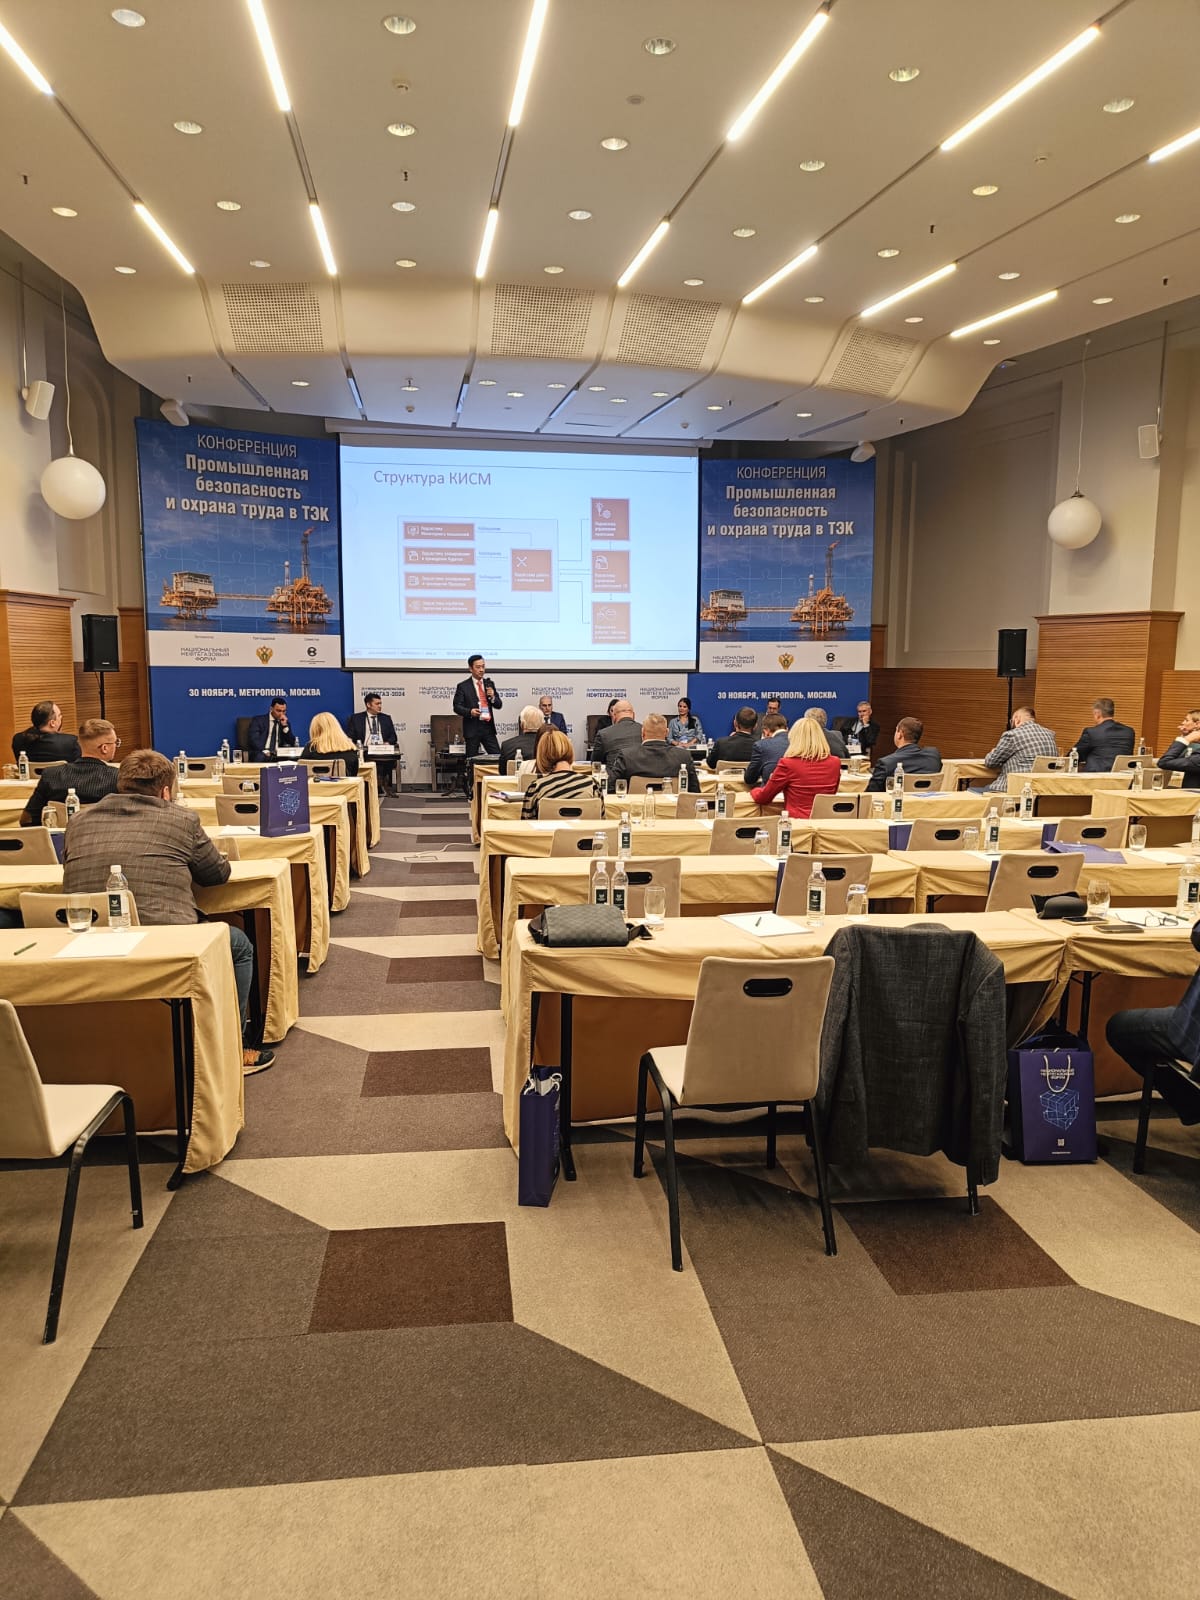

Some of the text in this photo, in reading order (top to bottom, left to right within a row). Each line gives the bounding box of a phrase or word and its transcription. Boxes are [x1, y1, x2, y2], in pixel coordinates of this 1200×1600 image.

[197, 434, 297, 458] КОНФЕРЕНЦИЯ
[185, 453, 309, 481] Промышленная
[736, 466, 826, 480] КОНФЕРЕНЦИЯ
[373, 470, 491, 487] Структура КИСМ
[196, 476, 301, 500] безопасность
[726, 485, 836, 502] Промышленная
[166, 497, 329, 522] и охрана труда в ТЭК
[733, 504, 828, 517] безопасность
[707, 521, 854, 538] и охрана труда в ТЭК
[189, 688, 321, 698] 30 НОЯБРЯ, МЕТРОПОЛЬ, МОСКВА
[728, 691, 759, 700] НОЯБРЯ,
[761, 691, 806, 700] МЕТРОПОЛЬ,
[807, 691, 837, 699] МОСКВА
